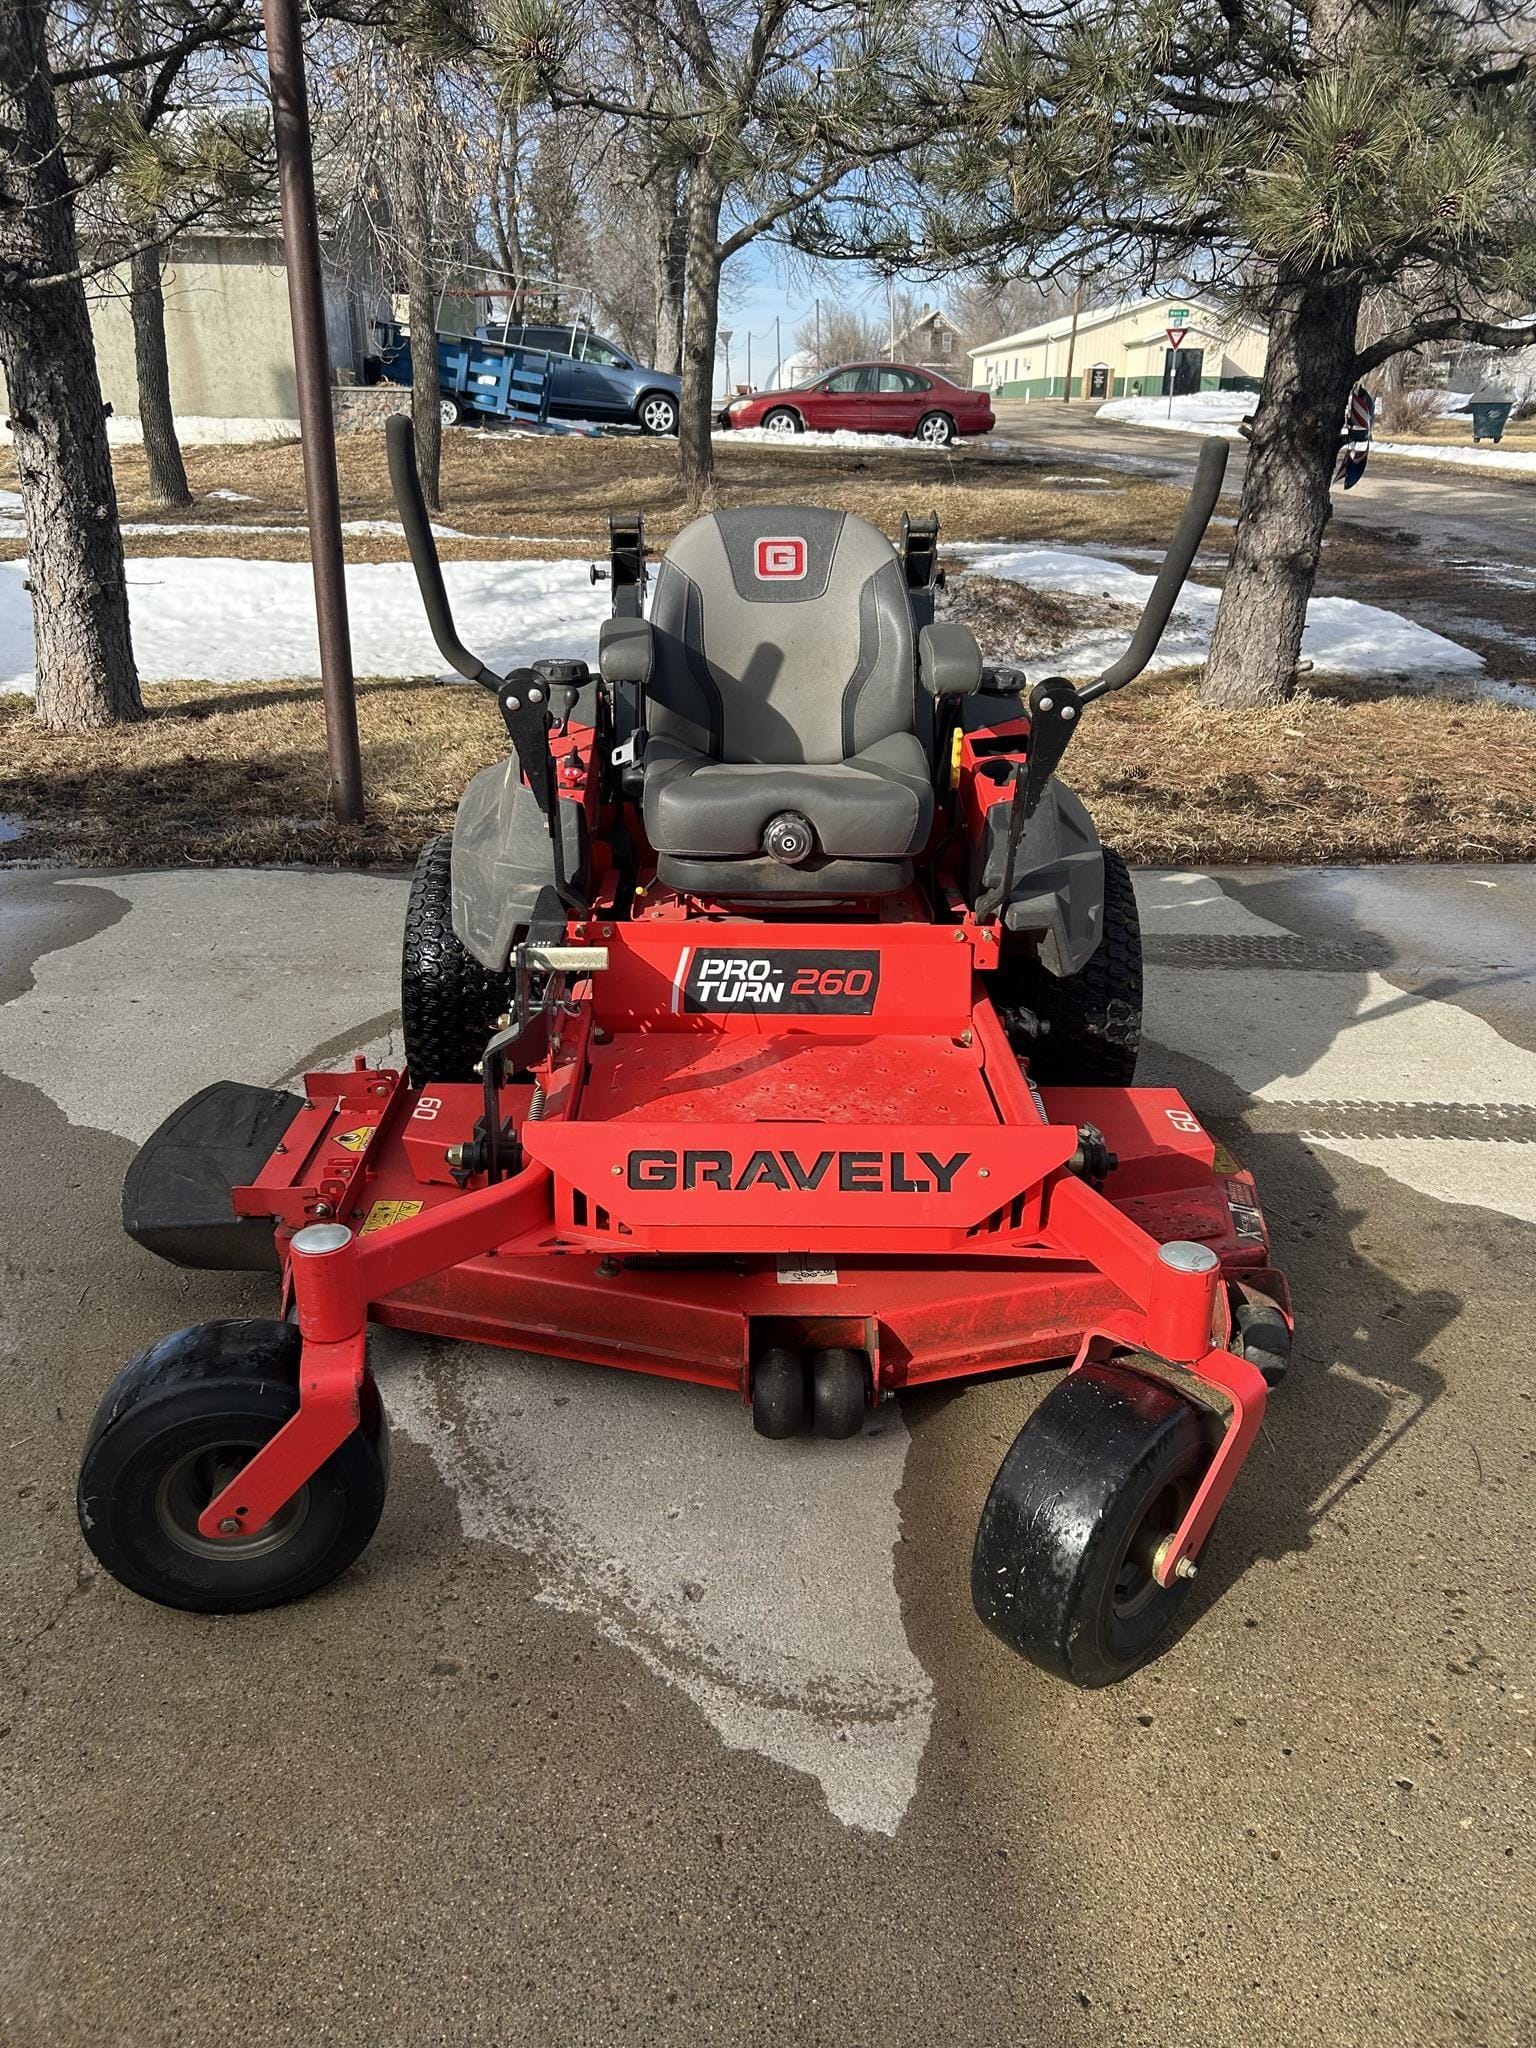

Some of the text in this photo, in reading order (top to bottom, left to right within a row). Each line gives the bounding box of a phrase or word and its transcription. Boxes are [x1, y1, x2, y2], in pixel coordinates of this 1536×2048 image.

[766, 546, 796, 571] G
[699, 959, 783, 980] PRO-
[697, 981, 785, 1002] TURN
[790, 968, 873, 996] 260
[412, 1097, 442, 1120] 60
[1164, 1109, 1201, 1132] 60
[627, 1150, 972, 1192] GRAVELY
